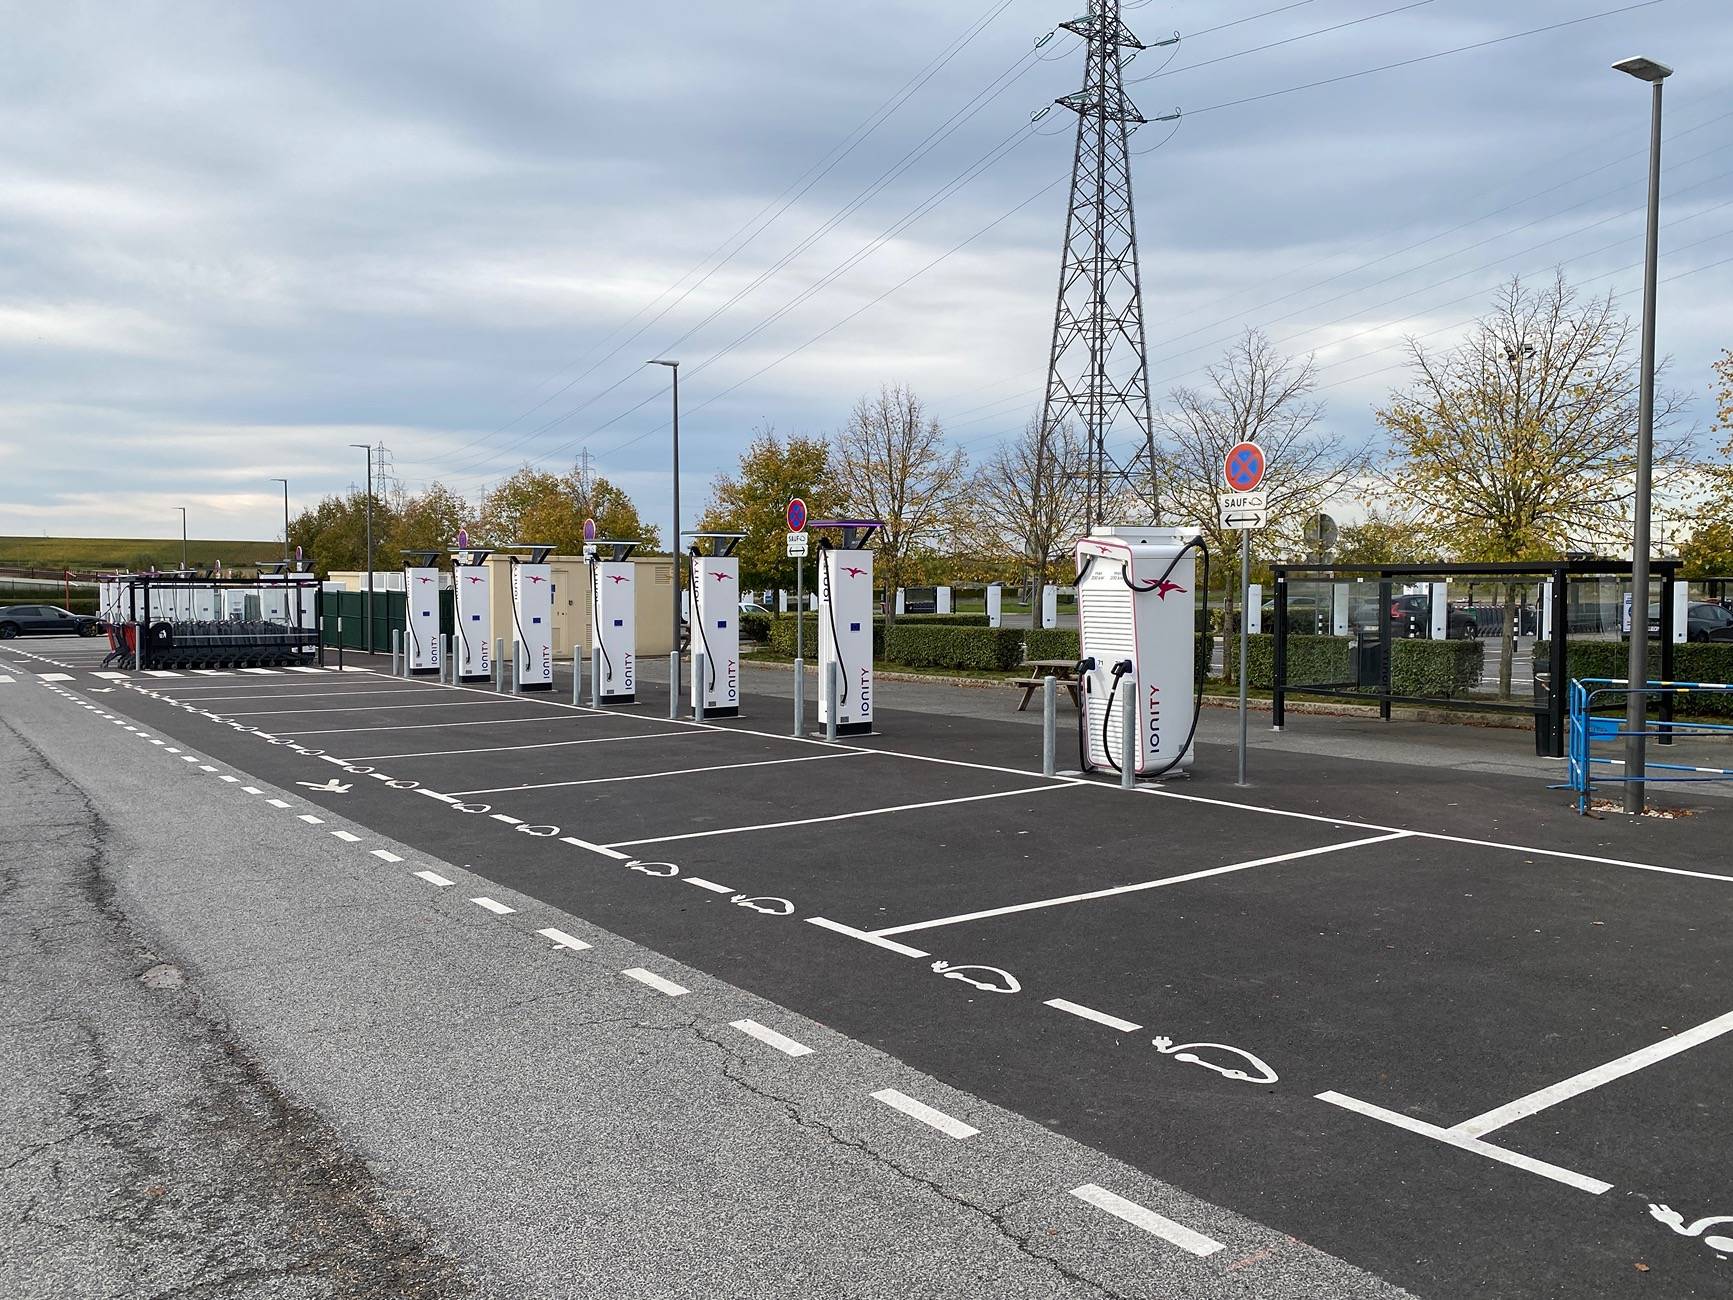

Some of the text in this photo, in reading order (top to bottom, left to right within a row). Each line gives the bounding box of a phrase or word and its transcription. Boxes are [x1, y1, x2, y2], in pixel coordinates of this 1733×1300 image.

[1224, 497, 1247, 508] SAUF
[728, 659, 736, 702] IONITY
[861, 668, 869, 716] IONITY
[1150, 685, 1160, 753] IONITY
